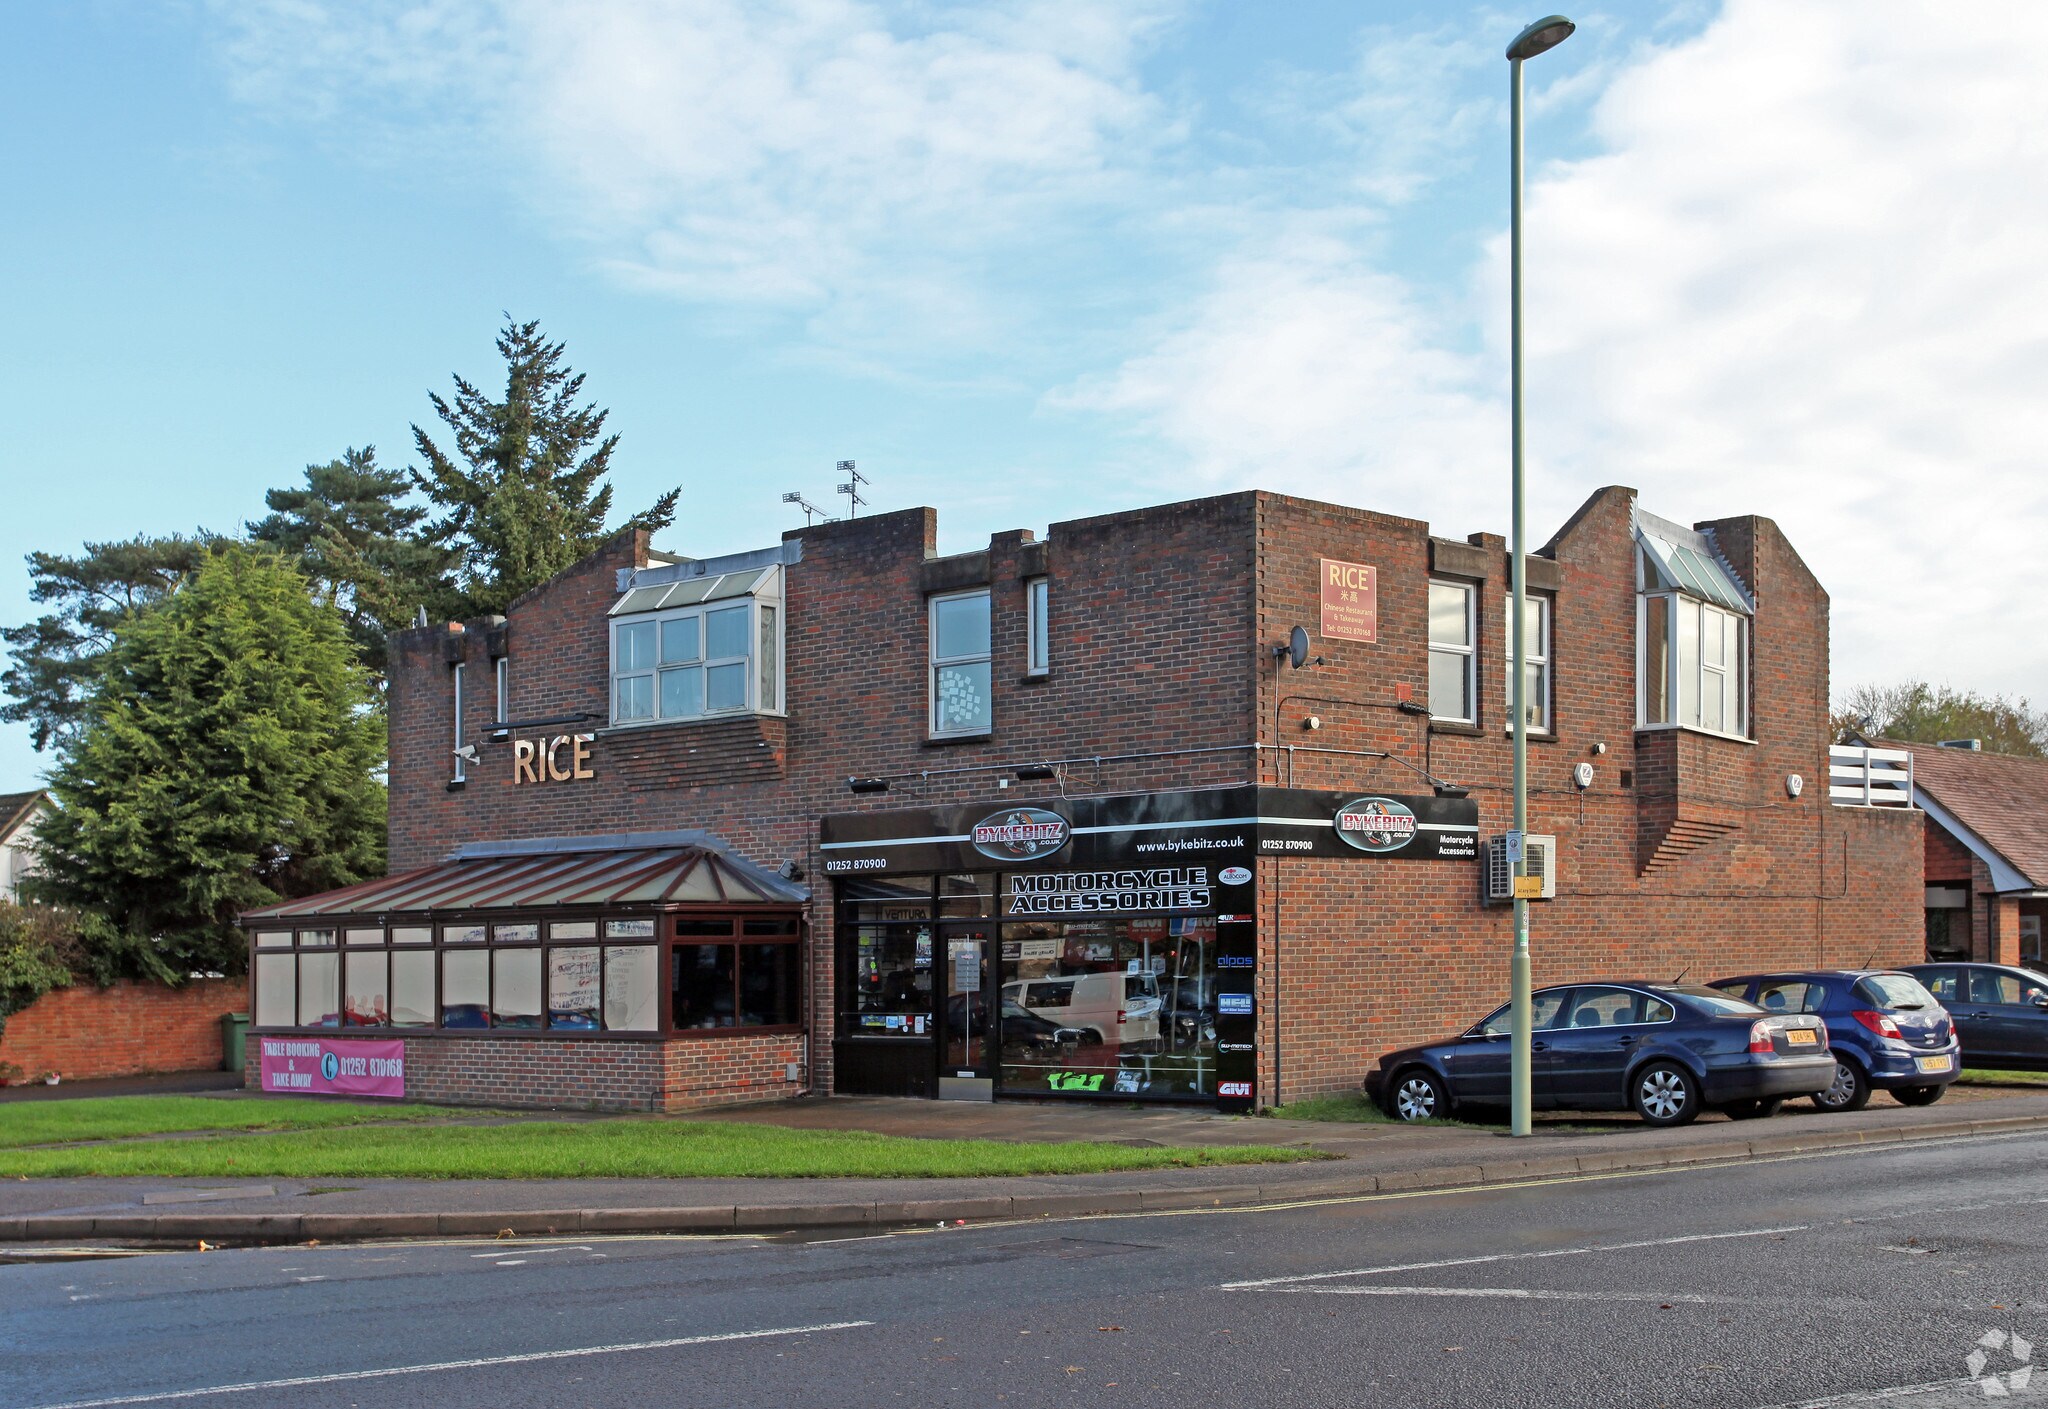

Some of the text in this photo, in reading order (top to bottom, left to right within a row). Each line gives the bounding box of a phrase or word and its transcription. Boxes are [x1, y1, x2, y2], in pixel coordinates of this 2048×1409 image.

[1329, 565, 1368, 590] RICE
[1324, 603, 1373, 616] Chinese Restaurant
[1340, 614, 1364, 625] Takeaway
[514, 733, 595, 784] RICE
[1341, 813, 1416, 832] BYKEBITZ
[975, 821, 1064, 844] BYKEBITZ
[1439, 834, 1474, 845] Motorcycle
[1136, 836, 1244, 853] www.bykebitz.co.uk
[1262, 840, 1313, 850] 01252 870900
[1438, 846, 1475, 856] Accessories
[826, 858, 887, 871] 01252 870900
[1011, 866, 1207, 894] MOTORCYCLE
[1008, 888, 1210, 914] ACCESSORIES
[264, 1042, 320, 1057] TABLE BOOKING
[288, 1059, 295, 1071] &
[340, 1057, 402, 1077] 01252 870168
[272, 1072, 312, 1088] TAKE AWAY
[1219, 1083, 1250, 1095] GIVI
